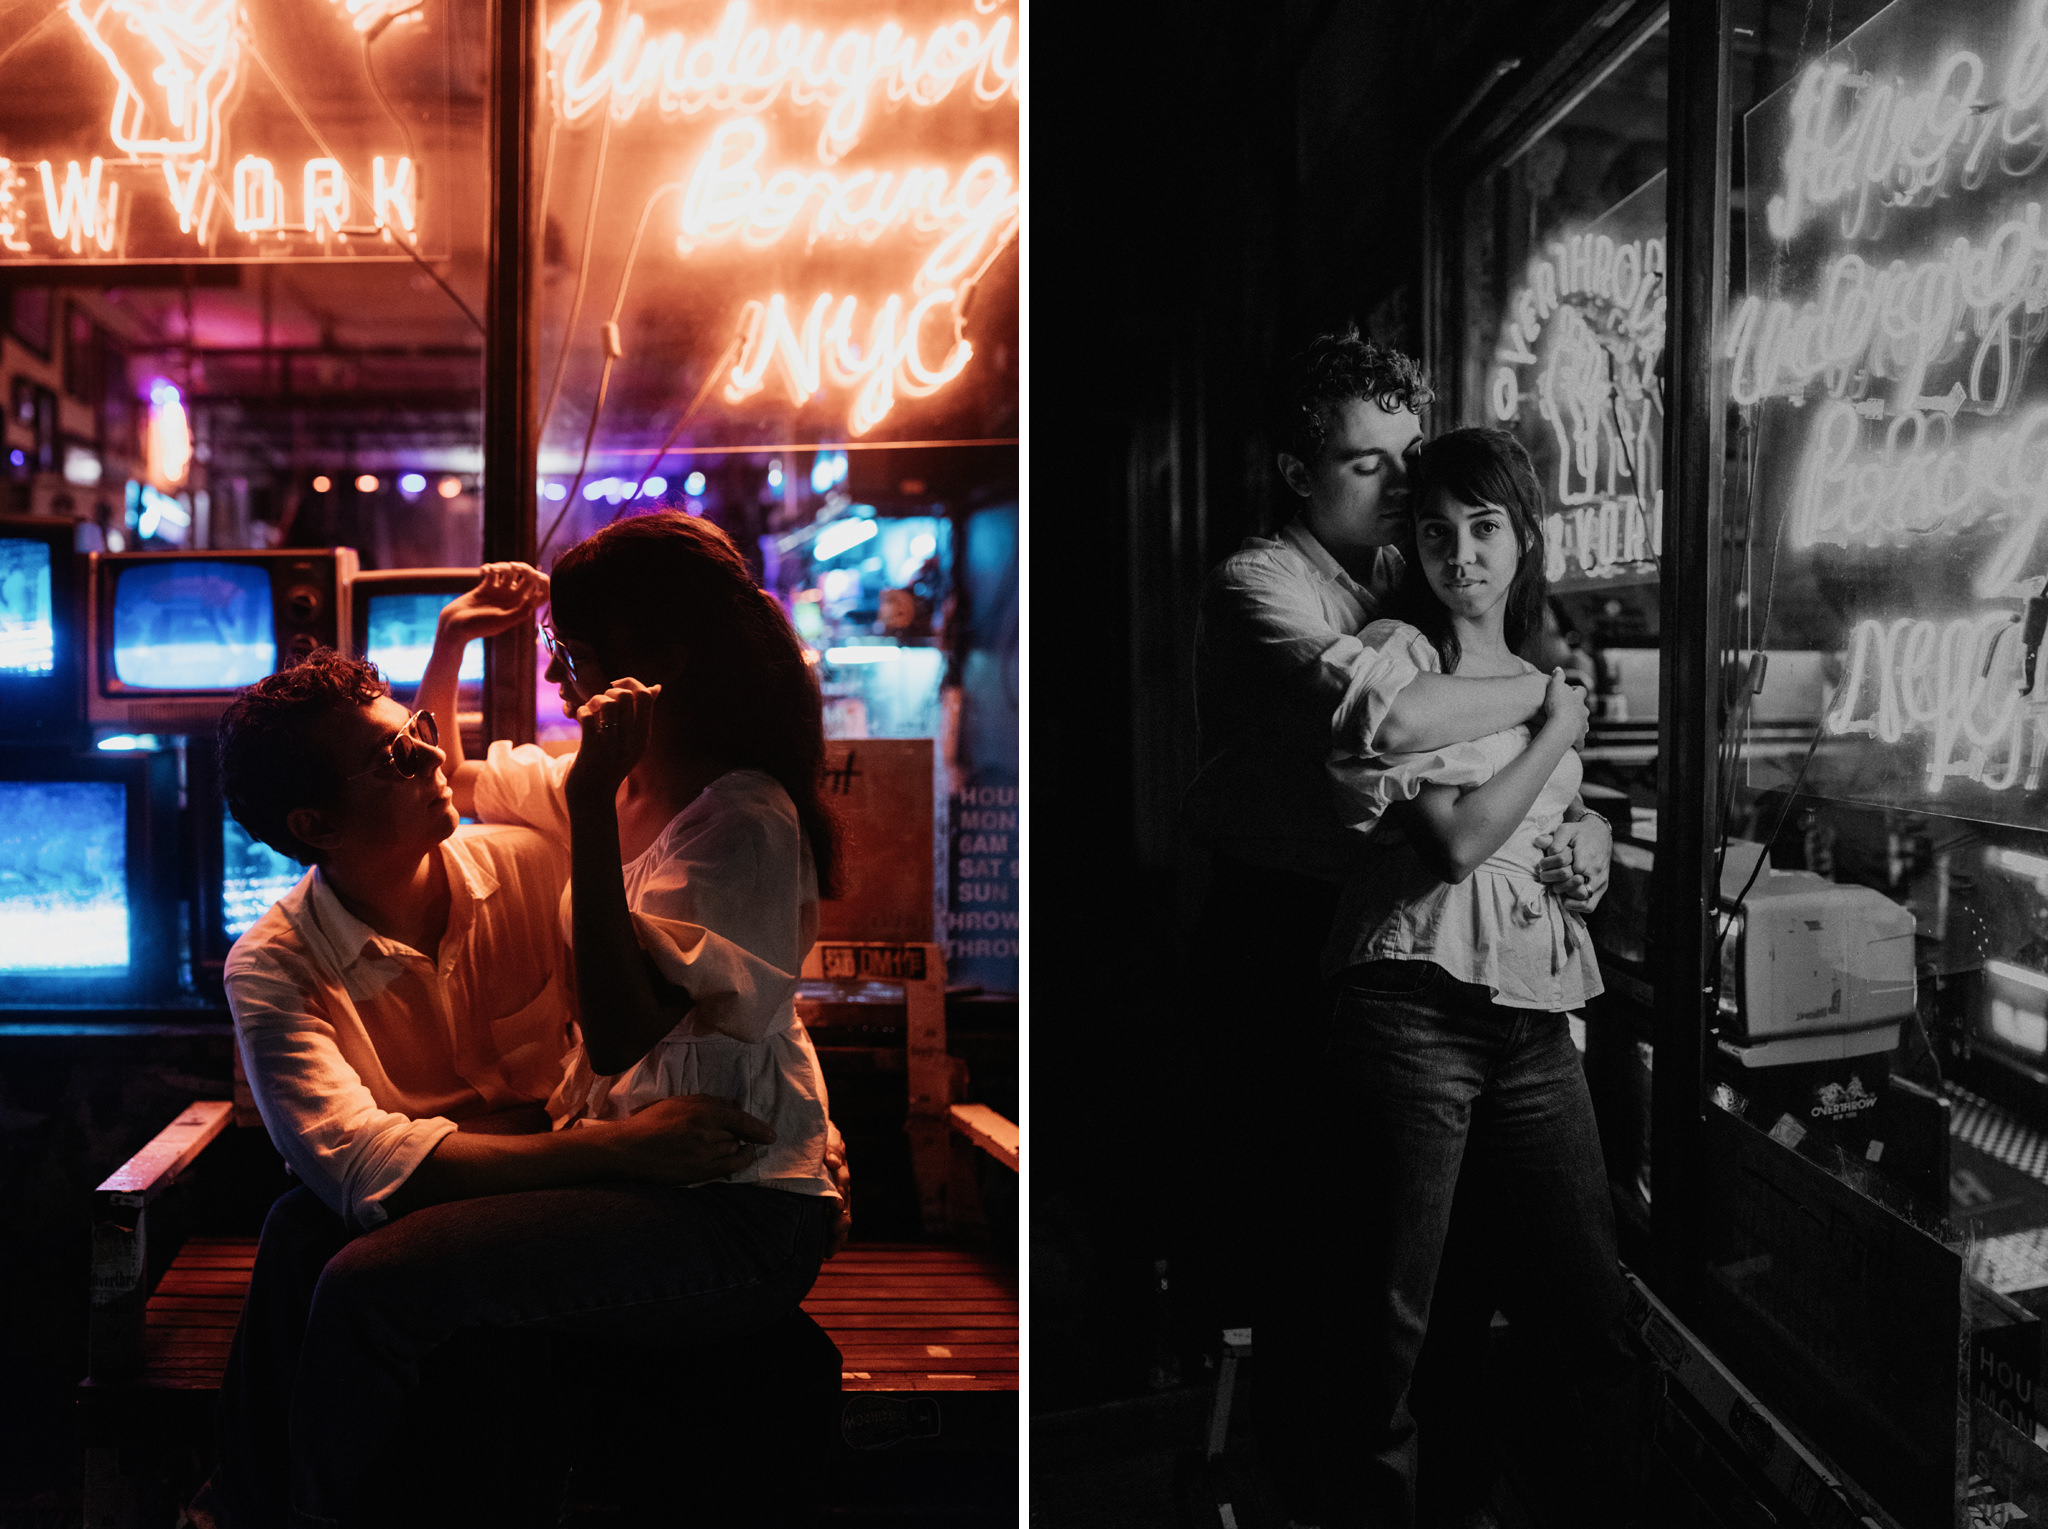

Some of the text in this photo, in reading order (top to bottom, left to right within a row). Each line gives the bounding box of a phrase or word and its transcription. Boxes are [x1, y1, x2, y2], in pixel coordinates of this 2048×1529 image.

[162, 155, 415, 234] YORK
[960, 786, 1018, 805] HOU
[1811, 1096, 1878, 1118] OVERTHROW
